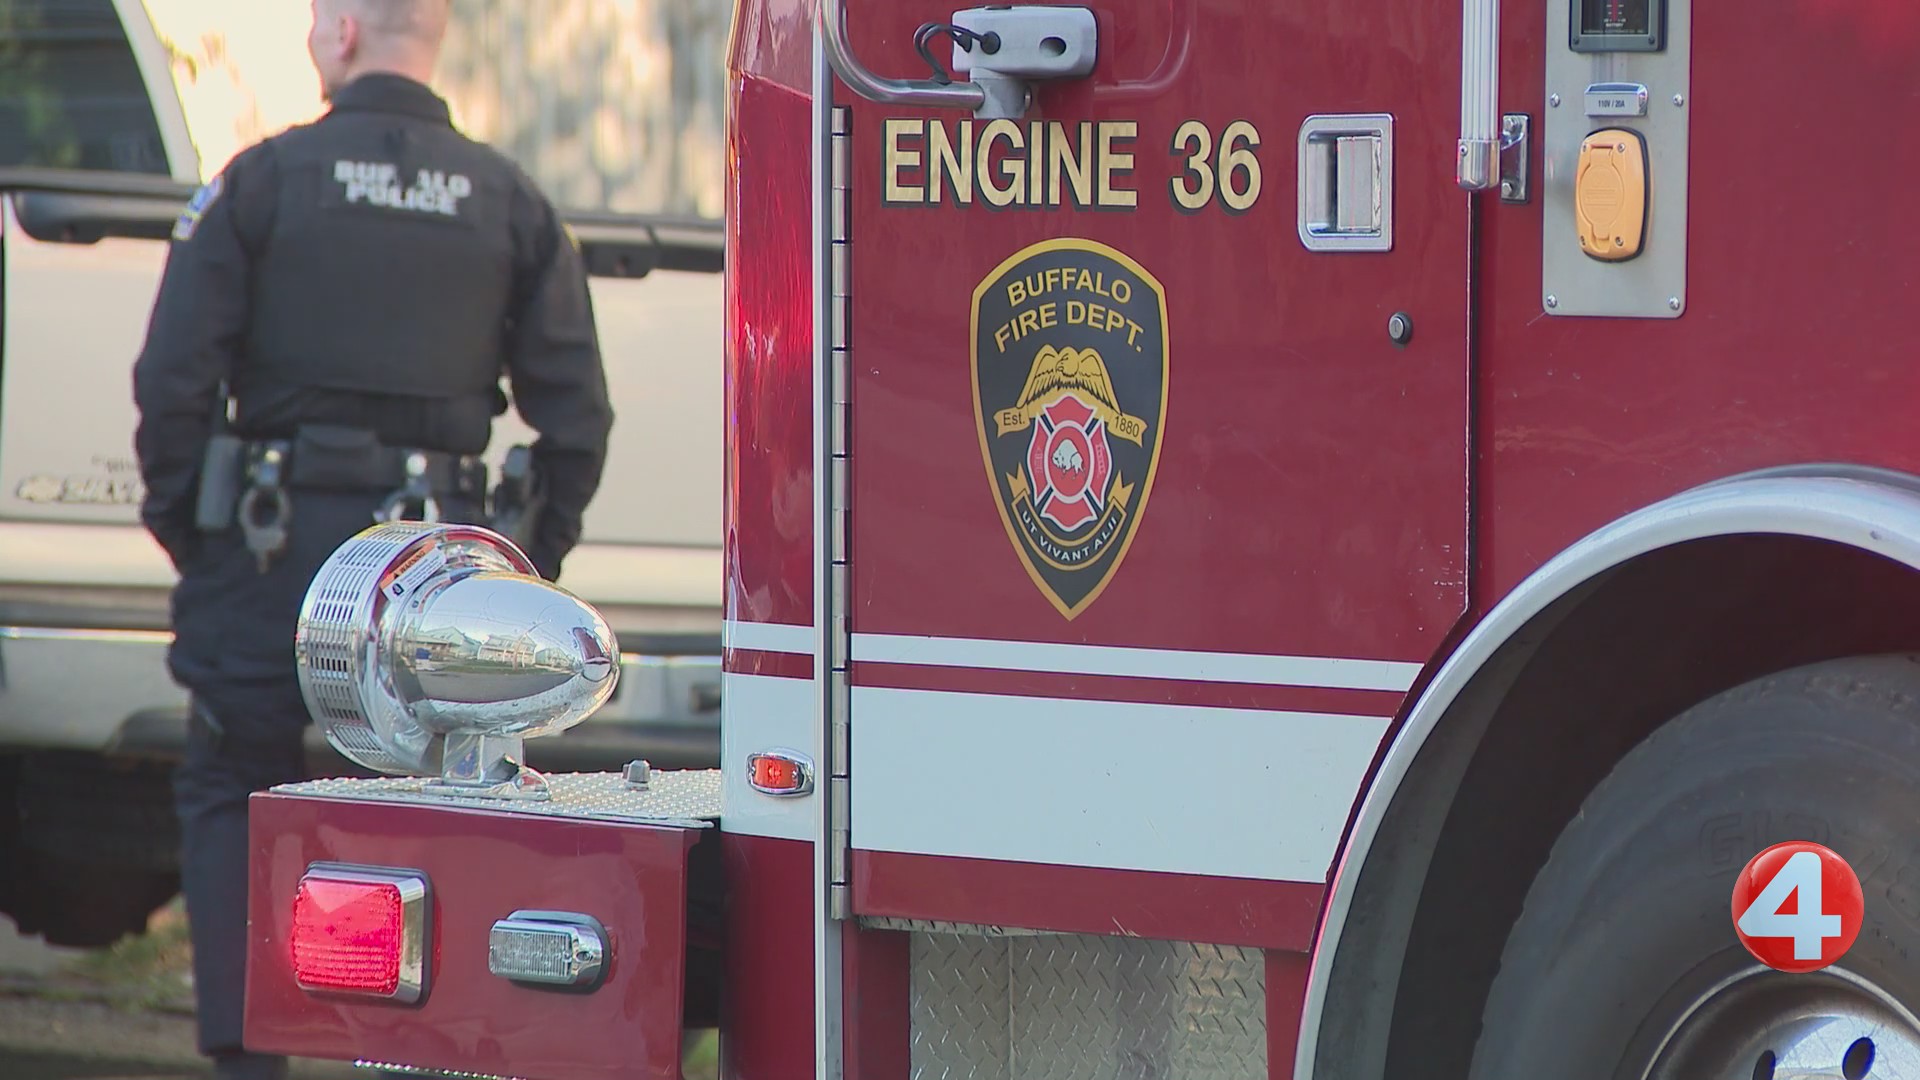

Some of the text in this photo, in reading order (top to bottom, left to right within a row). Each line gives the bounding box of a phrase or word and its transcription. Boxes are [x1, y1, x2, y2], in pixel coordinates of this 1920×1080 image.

[333, 159, 473, 199] BUFLO
[883, 118, 1263, 211] ENGINE 36
[345, 180, 458, 217] POLICE
[1006, 266, 1133, 308] BUFFALO
[993, 299, 1145, 354] FIRE DEPT.
[1003, 411, 1140, 438] Est. 1880
[1021, 510, 1118, 562] UT VIVANT ALII
